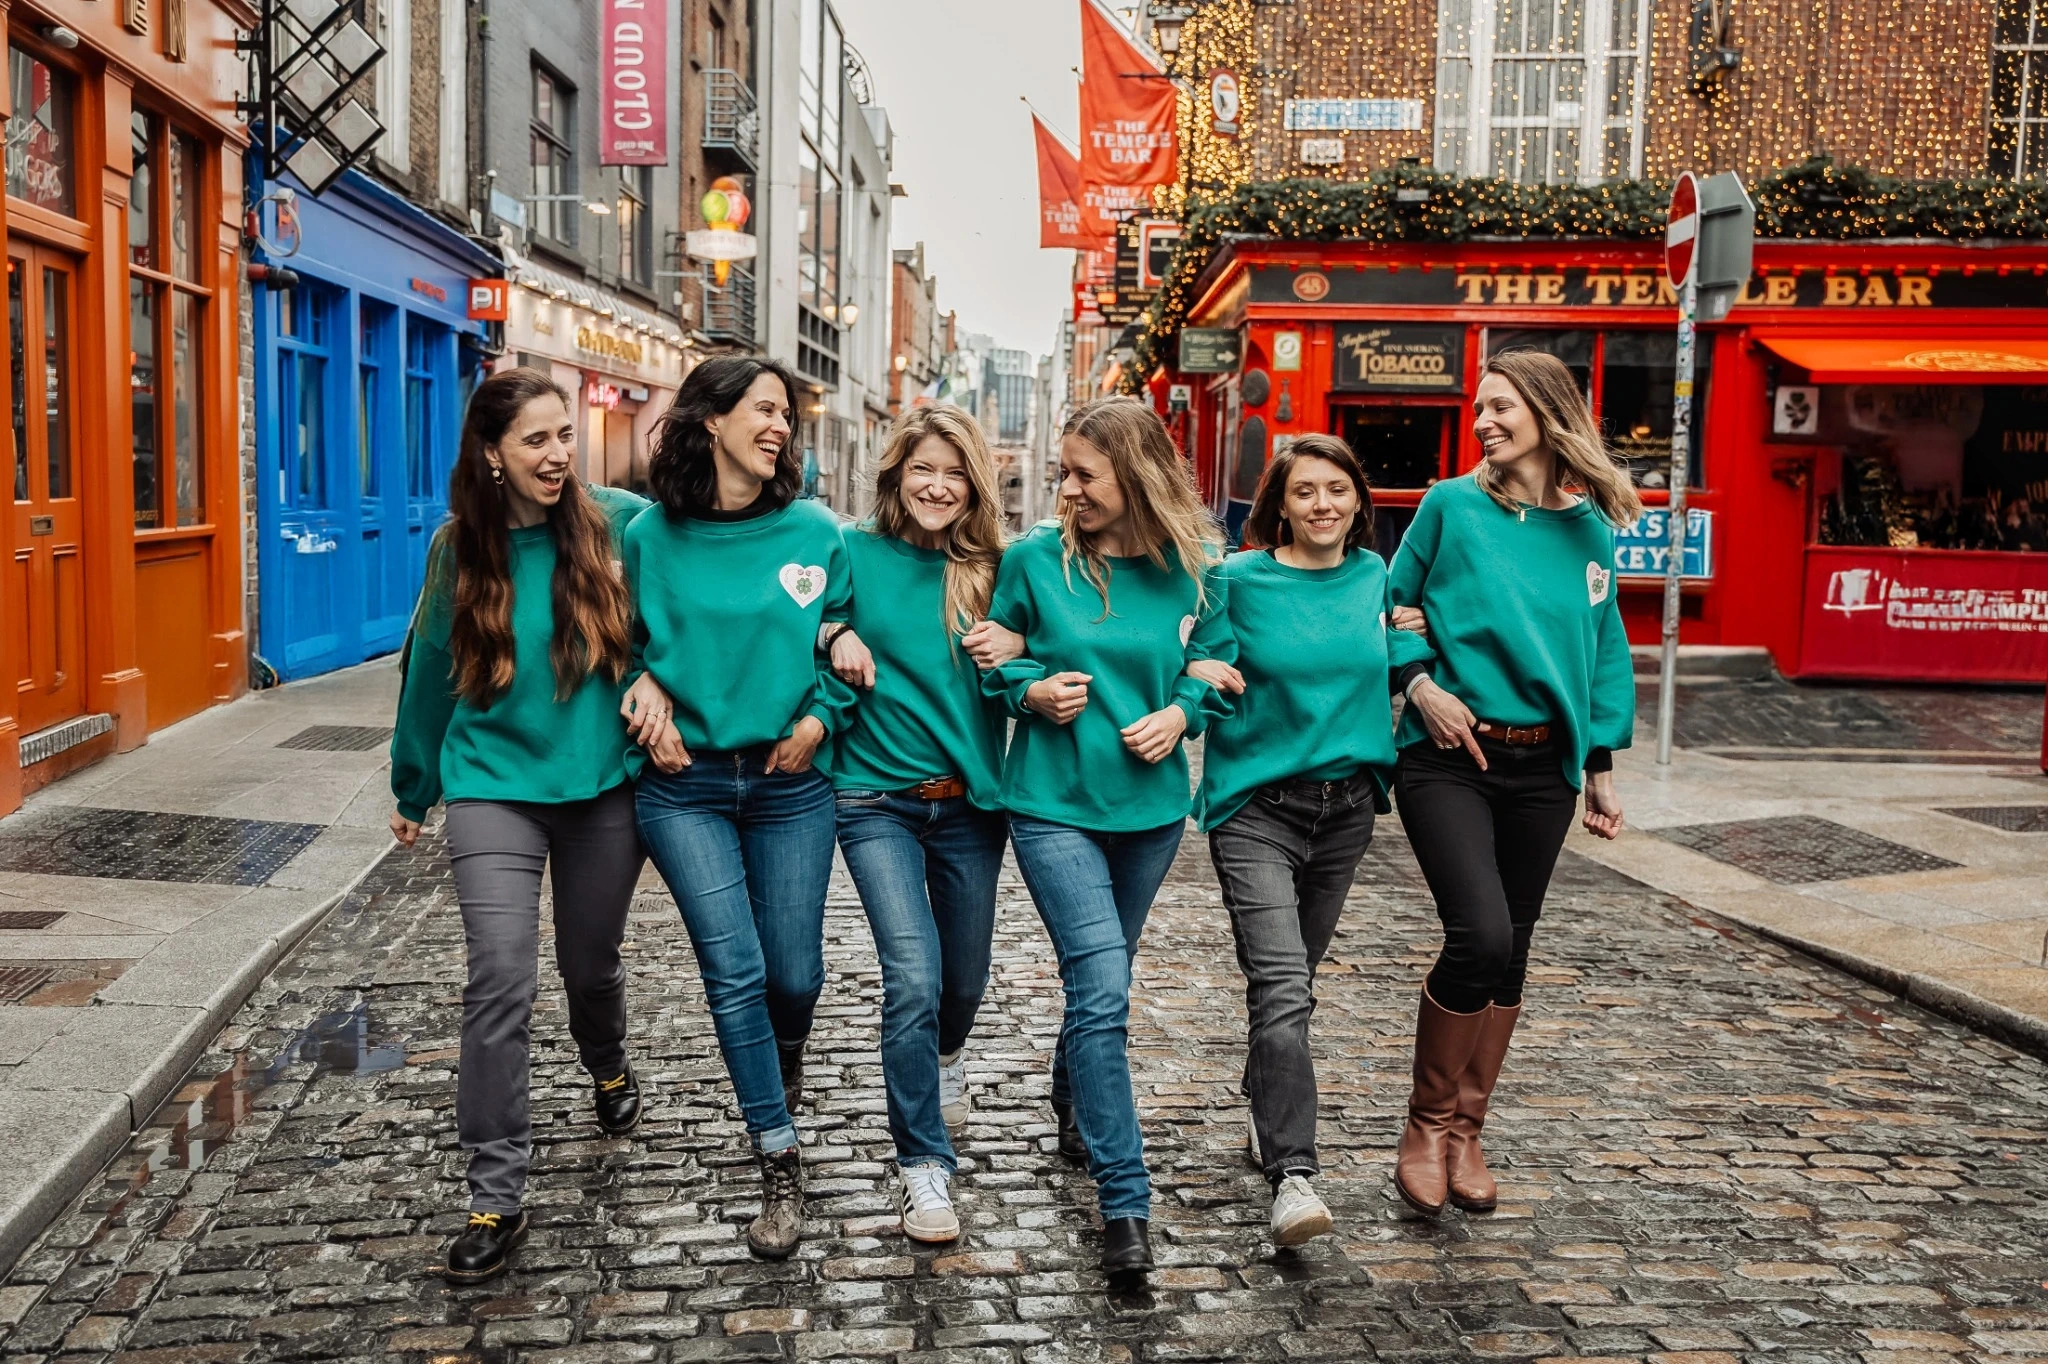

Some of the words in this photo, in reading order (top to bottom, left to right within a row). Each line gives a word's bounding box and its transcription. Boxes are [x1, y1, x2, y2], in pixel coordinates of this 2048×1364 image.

[613, 22, 653, 130] CLOUD
[1114, 120, 1147, 133] THE
[1089, 131, 1172, 149] TEMPLE
[1110, 148, 1153, 164] BAR
[1102, 185, 1131, 197] THE
[471, 286, 502, 312] PI
[1456, 274, 1566, 304] THE
[1586, 275, 1798, 306] TEMLE
[1823, 276, 1933, 306] BAR
[1355, 348, 1446, 380] TOBACCO
[2021, 588, 2048, 605] TH
